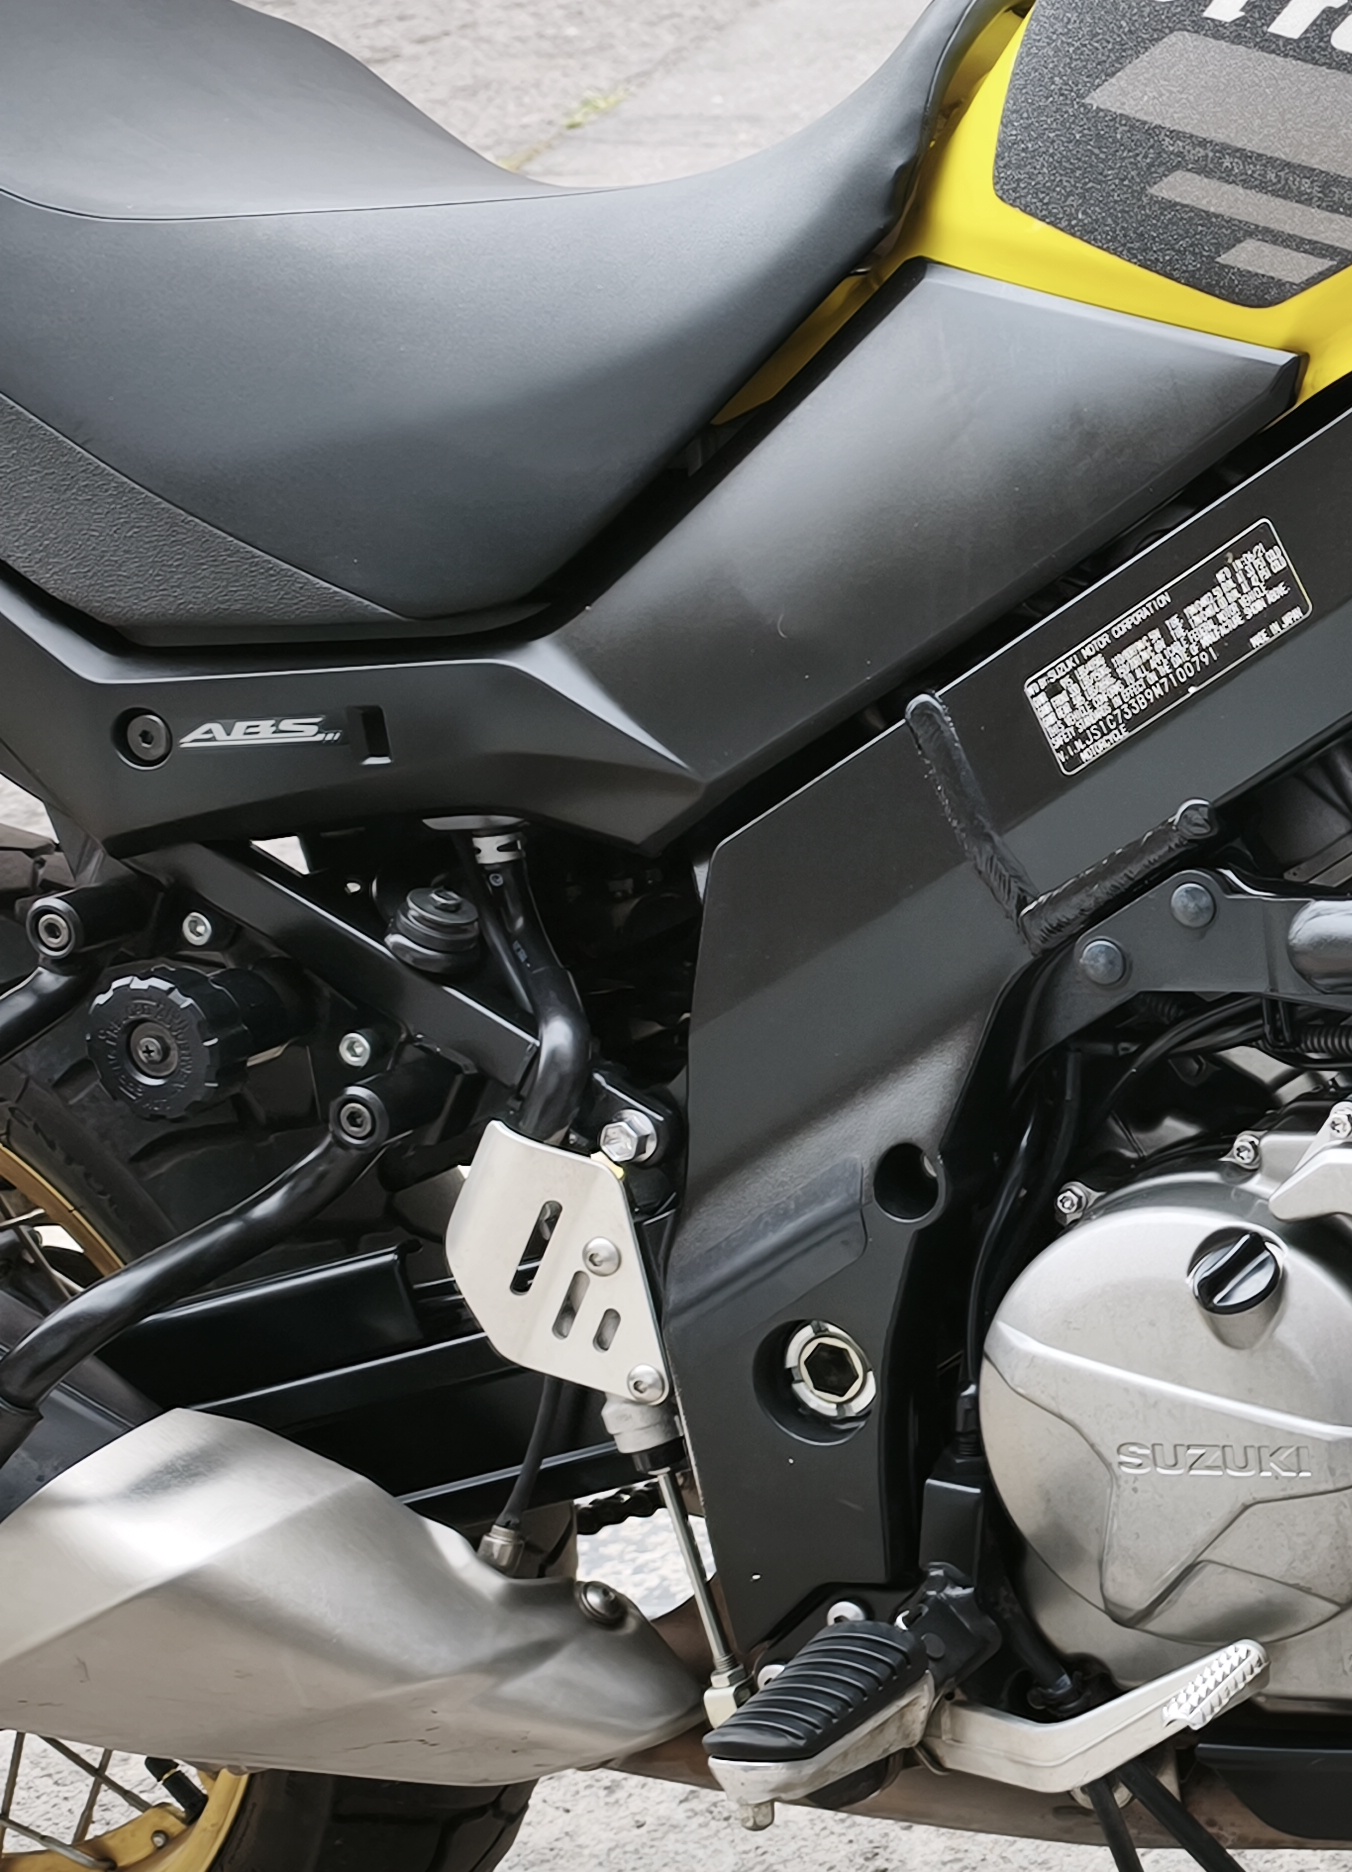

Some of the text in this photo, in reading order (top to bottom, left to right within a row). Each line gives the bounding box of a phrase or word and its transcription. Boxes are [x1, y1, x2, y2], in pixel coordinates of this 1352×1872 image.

[1080, 632, 1112, 660] MOTOR
[1109, 590, 1172, 640] CORPORATION
[179, 715, 326, 746] ABS
[1116, 1441, 1312, 1477] SUZUKI
